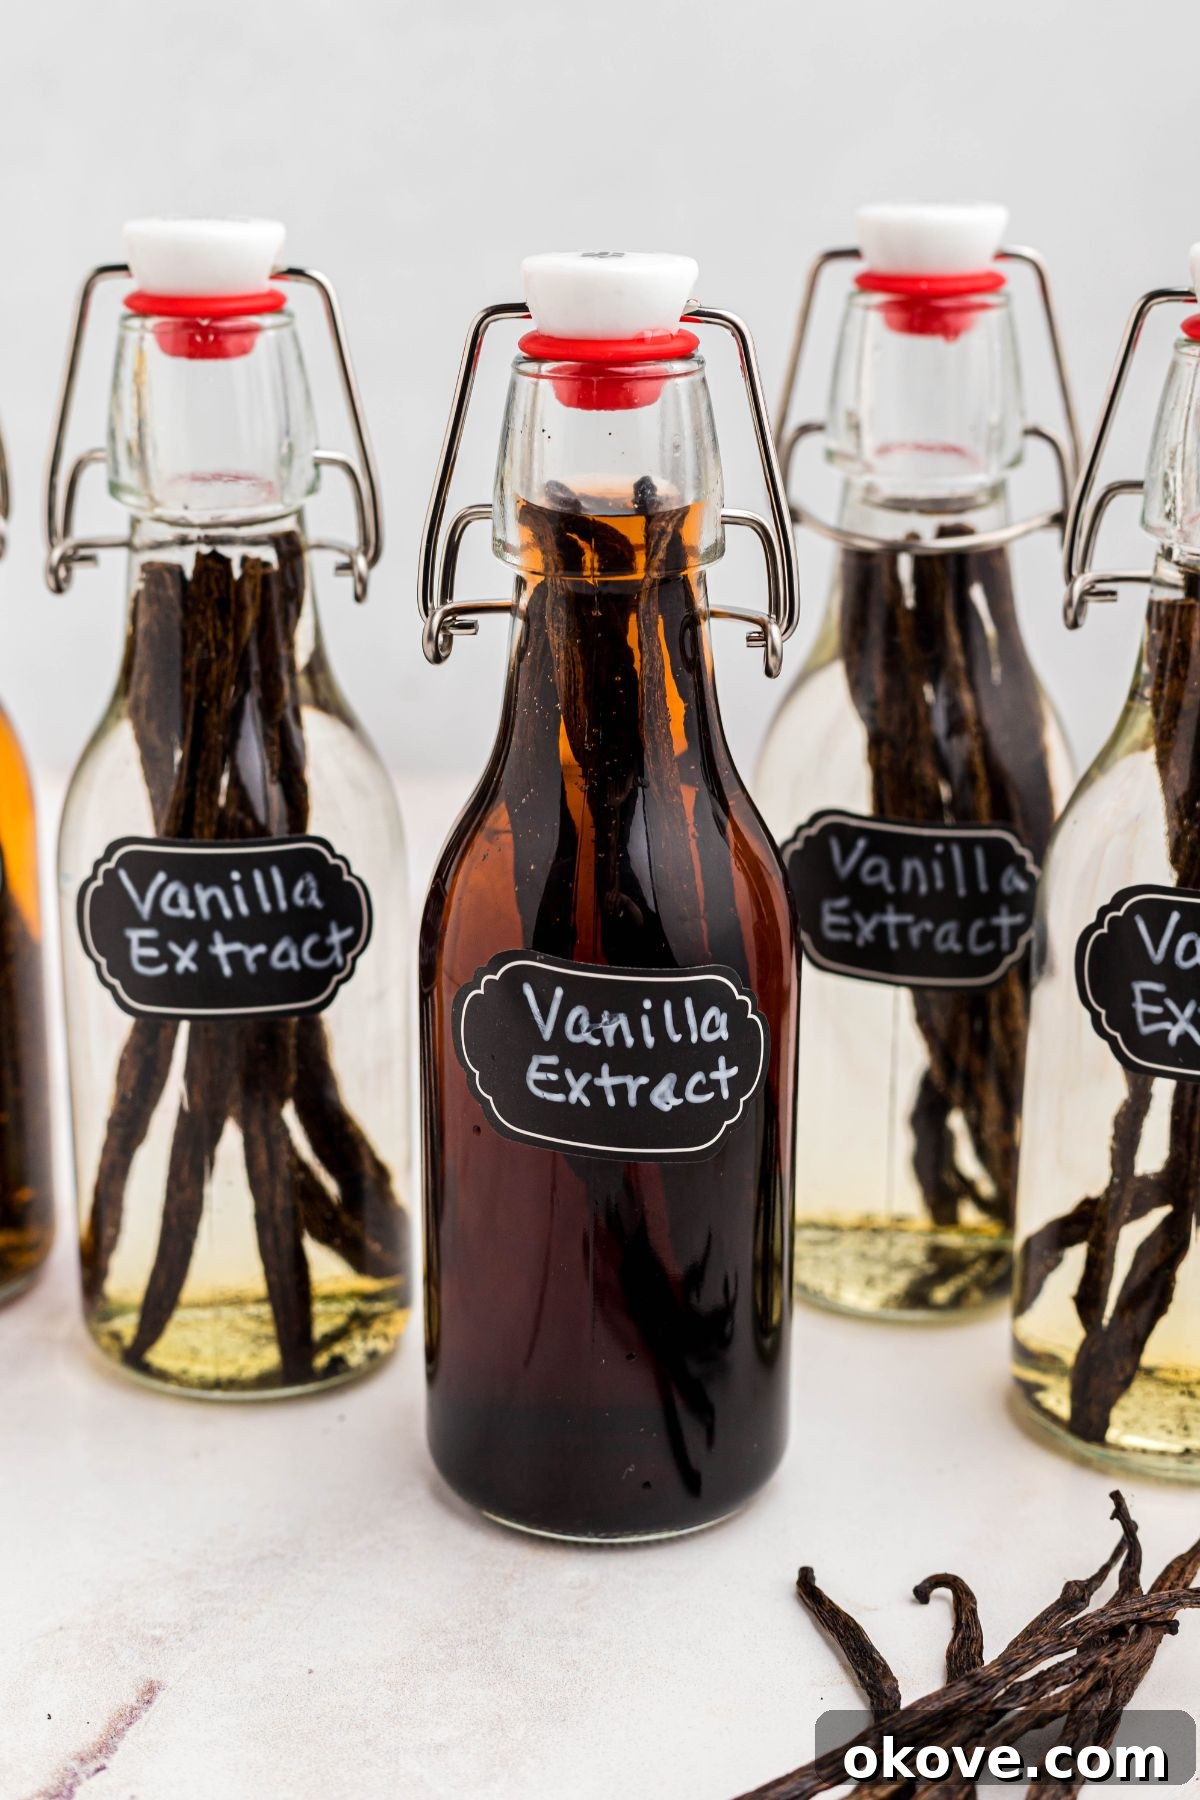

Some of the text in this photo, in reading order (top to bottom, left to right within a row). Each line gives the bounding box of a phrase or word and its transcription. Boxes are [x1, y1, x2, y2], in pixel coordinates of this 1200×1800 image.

[117, 864, 324, 922] Vanilla
[828, 836, 1029, 897] Vanilla
[123, 920, 354, 979] Extract
[820, 896, 1026, 954] Extract
[522, 981, 729, 1049] Vanilla
[1131, 980, 1200, 1047] Ex
[526, 1055, 739, 1112] Extract
